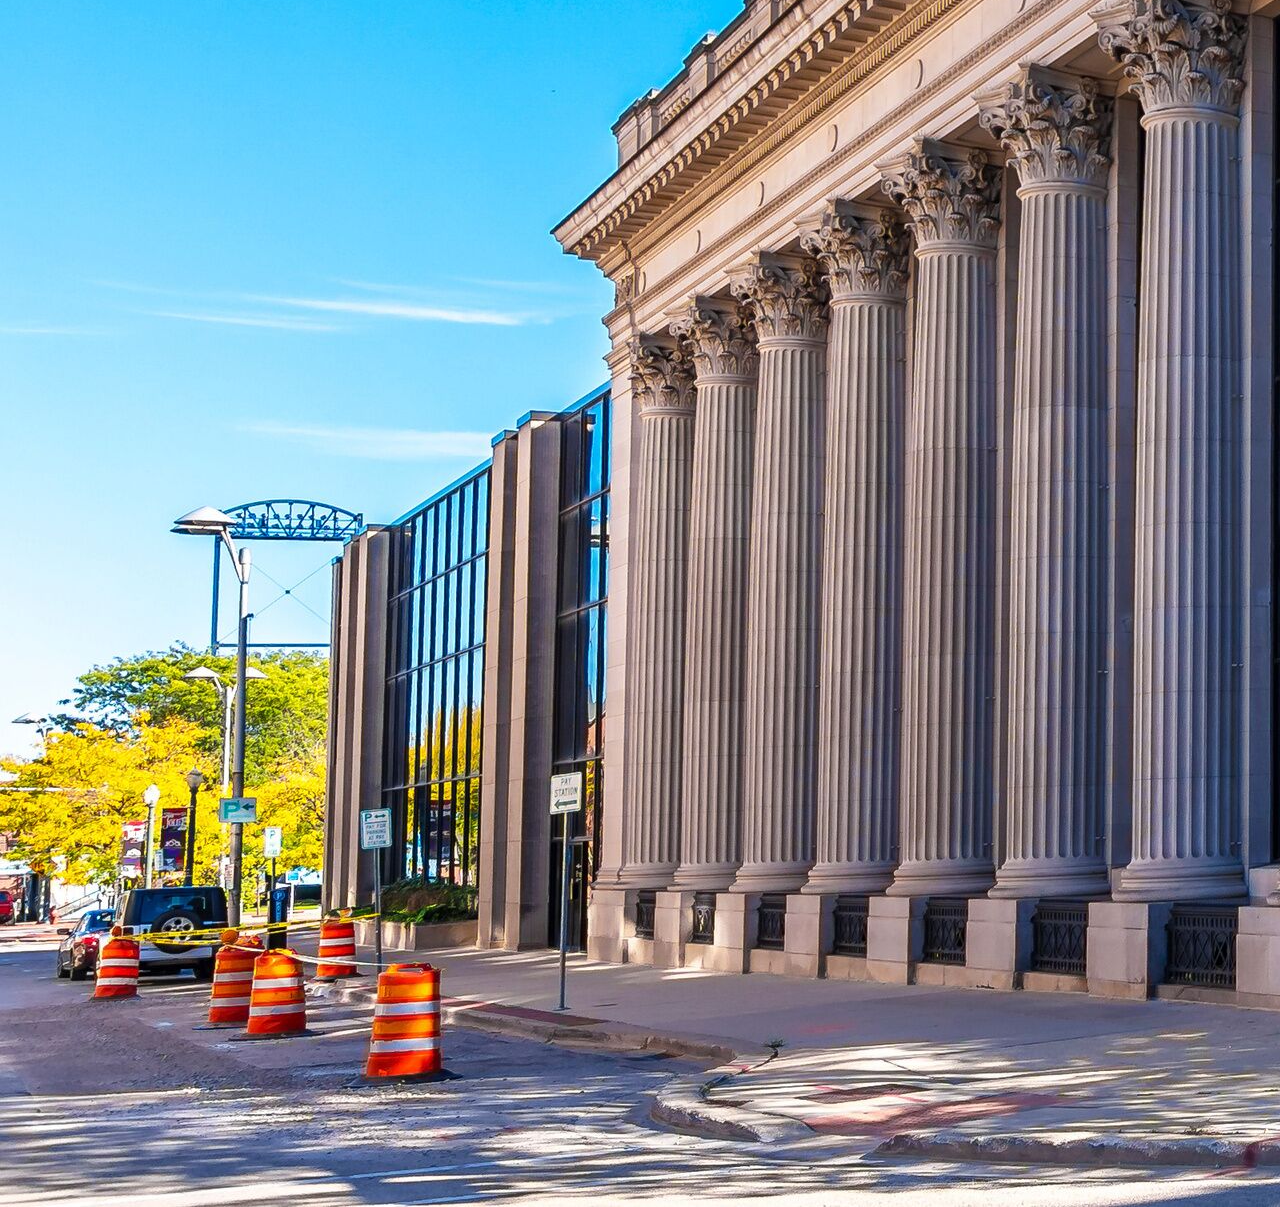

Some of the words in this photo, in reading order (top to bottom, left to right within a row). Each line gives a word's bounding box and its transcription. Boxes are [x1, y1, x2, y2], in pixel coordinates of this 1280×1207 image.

[560, 777, 573, 785] PAY
[554, 786, 578, 798] STATION
[223, 800, 240, 820] P
[364, 813, 373, 822] P
